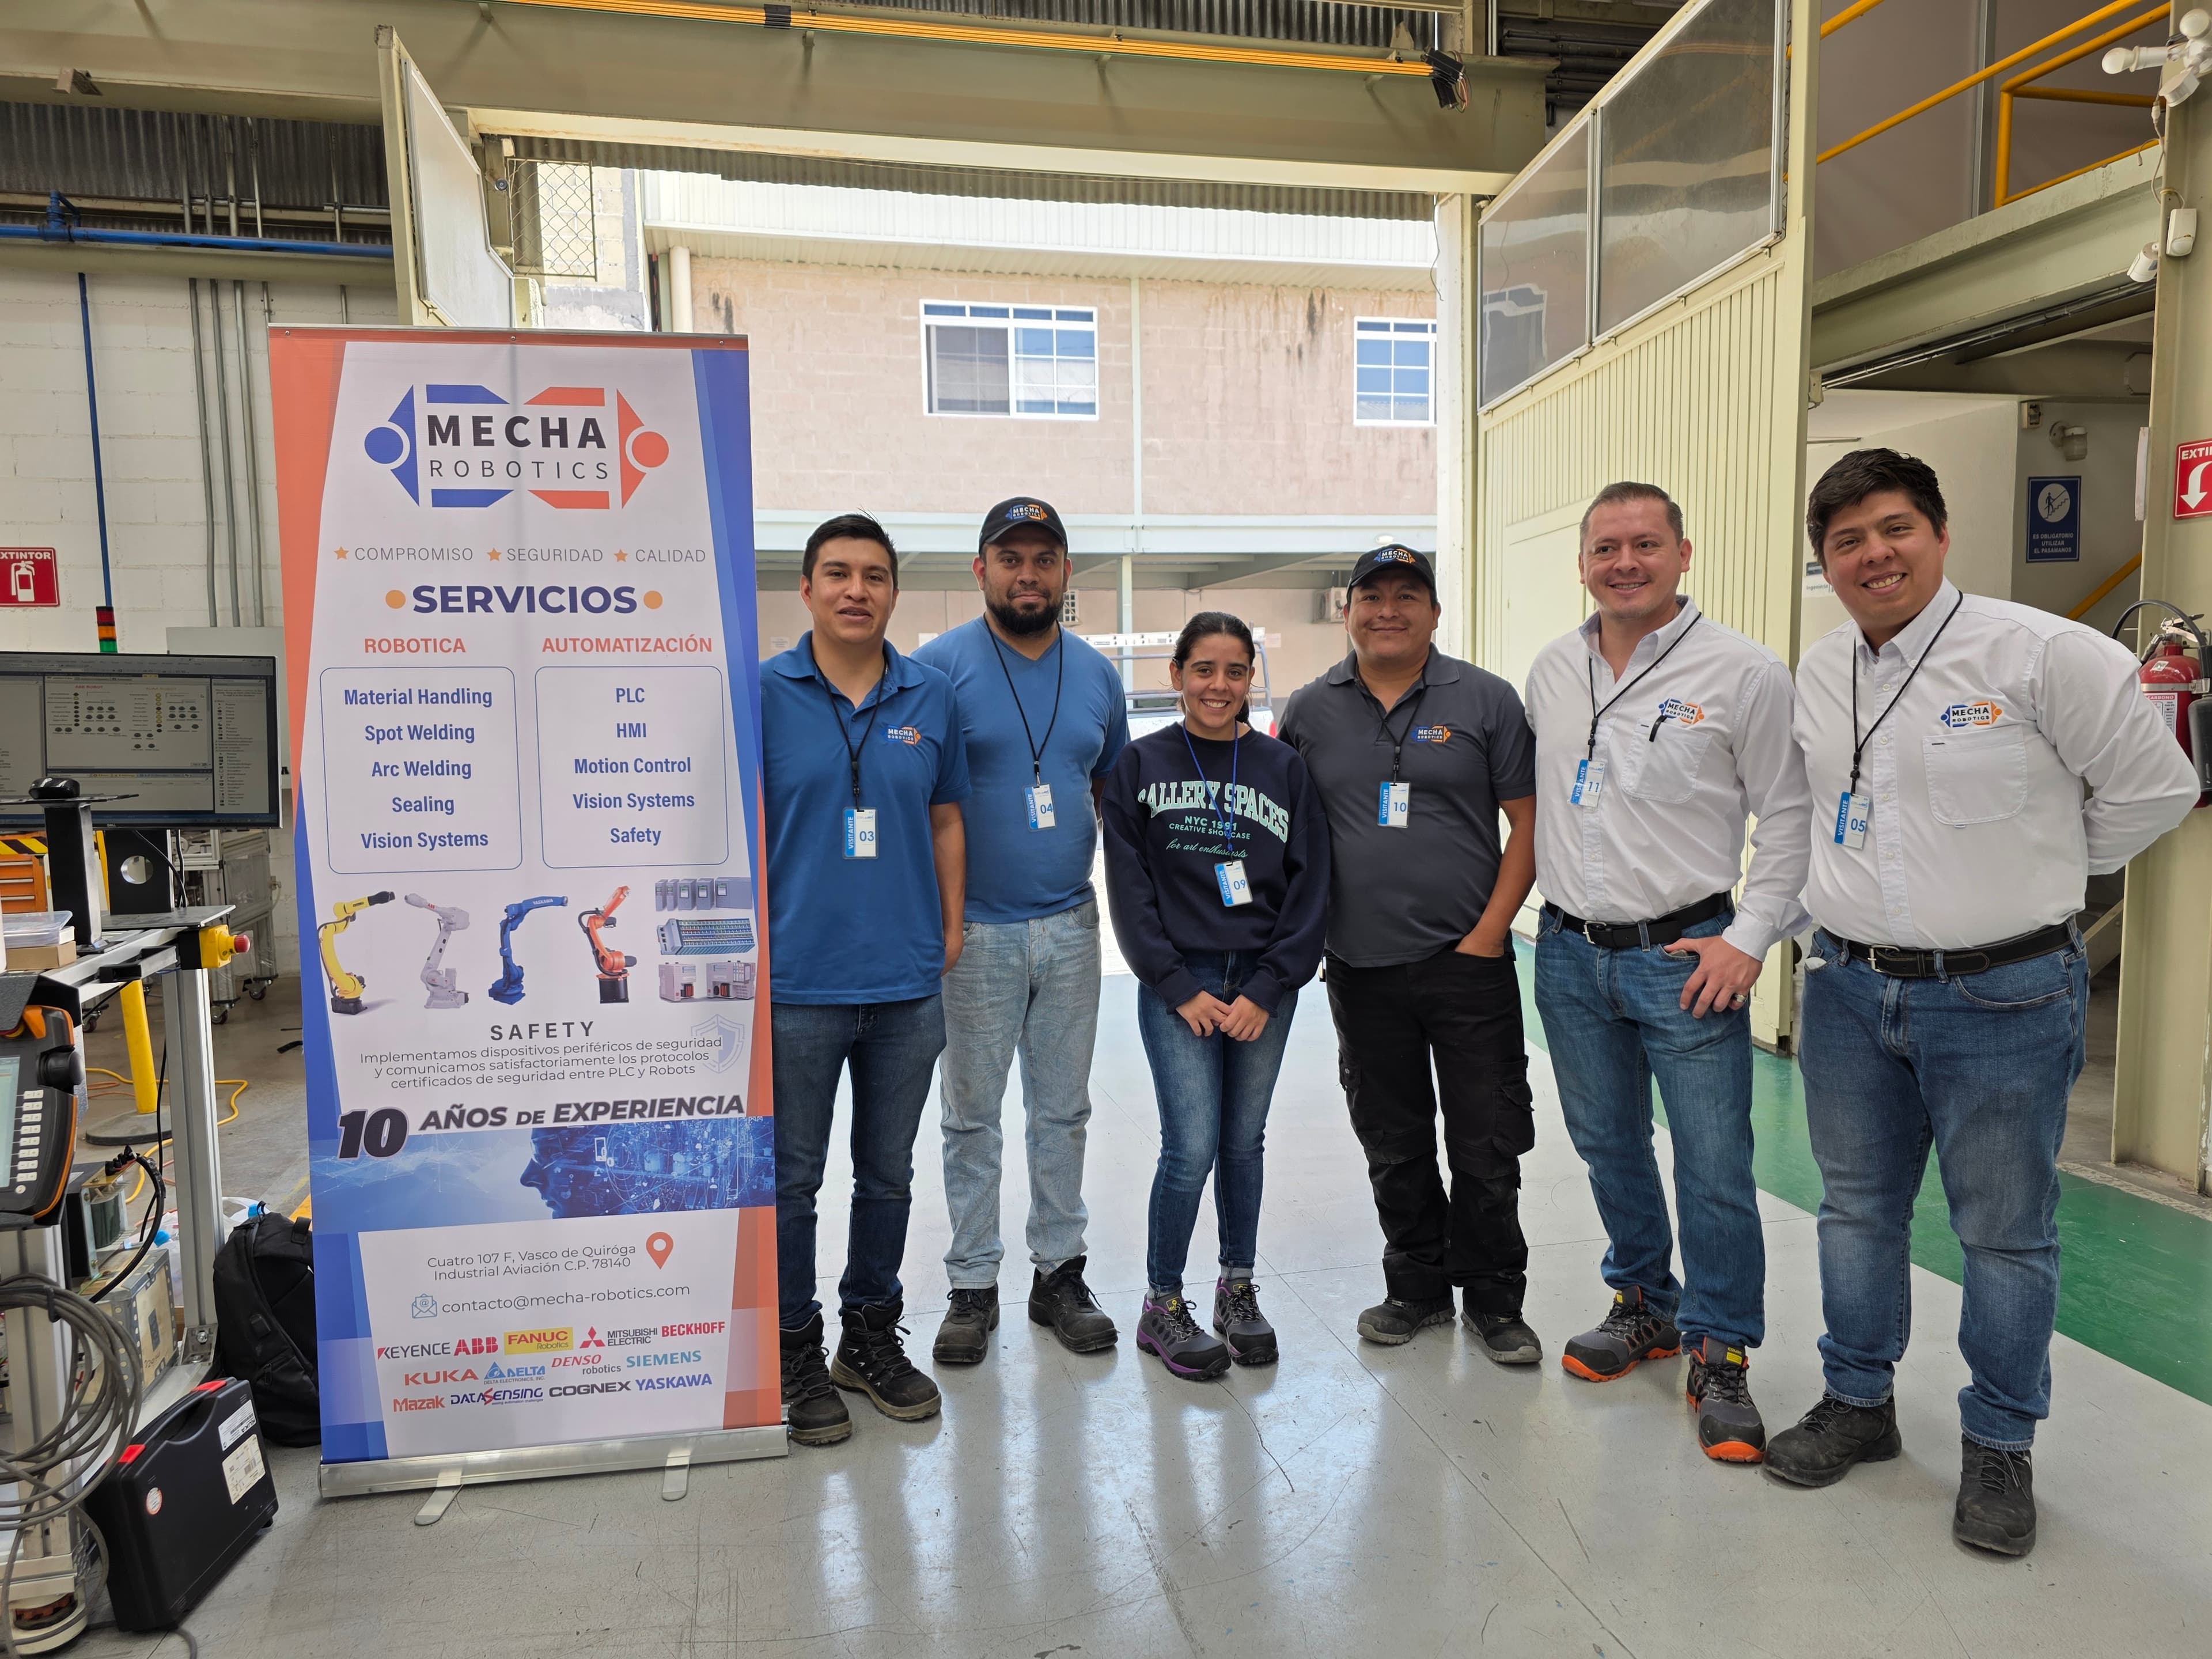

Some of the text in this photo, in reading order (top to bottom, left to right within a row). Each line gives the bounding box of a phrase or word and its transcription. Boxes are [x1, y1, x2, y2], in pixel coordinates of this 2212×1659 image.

[427, 415, 607, 449] MECHA
[430, 459, 609, 480] ROBOTICS
[0, 551, 51, 560] XTINTOR
[355, 546, 474, 561] COMPROMISO
[507, 547, 604, 562] SEGURIDAD
[635, 548, 706, 563] CALIDAD
[412, 585, 638, 614] SERVICIOS
[364, 637, 466, 654] ROBOTICA
[542, 634, 713, 653] AUTOMATIZACIÓN
[344, 688, 493, 708] Material Handling
[616, 687, 645, 703] PLC
[1666, 710, 1694, 719] ROBOTICS
[1668, 703, 1695, 714] MECHA
[1952, 707, 1989, 716] MECHA
[364, 724, 475, 745] Spot Welding
[616, 722, 647, 738] HMI
[888, 728, 913, 736] MECHA
[371, 760, 472, 780] Arc Welding
[574, 756, 691, 774] Motion Control
[1589, 781, 1600, 793] 11
[392, 796, 454, 816] Sealing
[573, 791, 695, 812] Vision Systems
[1028, 794, 1036, 823] VISITANTE
[1040, 803, 1053, 814] 04
[1394, 802, 1407, 812] 10
[1225, 783, 1289, 843] SPACES
[1838, 800, 1848, 836] VISITANTE
[1169, 823, 1206, 834] CREATIVE
[1184, 815, 1237, 831] NYC 1991
[1851, 818, 1866, 832] 05
[361, 832, 489, 852] Vision Systems
[609, 827, 662, 846] Safety
[859, 831, 874, 842] 03
[1166, 838, 1181, 850] for
[1183, 843, 1197, 851] art
[1220, 870, 1230, 900] VISITANTE
[1233, 879, 1246, 891] 09
[490, 1021, 594, 1040] SAFETY
[361, 1037, 722, 1065] Implementamos dispositivos periféricos de seguridad
[374, 1050, 710, 1079] y comunicamos satisfactoriamente los protocolos
[391, 1064, 695, 1089] certificados de seguridad entre PLC y Robots
[339, 1094, 745, 1159] 10 AÑOS DE EXPERIENCIA
[427, 1244, 636, 1268] Cuatro 107 F, Vasco de Quiróga
[434, 1257, 631, 1281] Industrial Aviación C.P. 78140
[442, 1285, 690, 1313] contacto@mecha-robotics.com
[607, 1327, 658, 1338] MITSUBISHI
[662, 1321, 725, 1337] BECKHOFF
[454, 1336, 499, 1357] ABB
[507, 1331, 569, 1345] FANUC
[537, 1340, 569, 1351] Robotics
[608, 1336, 652, 1347] ELECTRIC
[377, 1342, 451, 1360] KEYENCE
[626, 1350, 702, 1368] SIEMENS
[551, 1354, 602, 1368] DENSO
[582, 1364, 622, 1375] robotics
[404, 1368, 479, 1386] KUKA
[507, 1365, 546, 1378] DELTA
[549, 1380, 632, 1397] COGNEX
[635, 1374, 713, 1391] YASKAWA
[393, 1395, 446, 1412] Mazak
